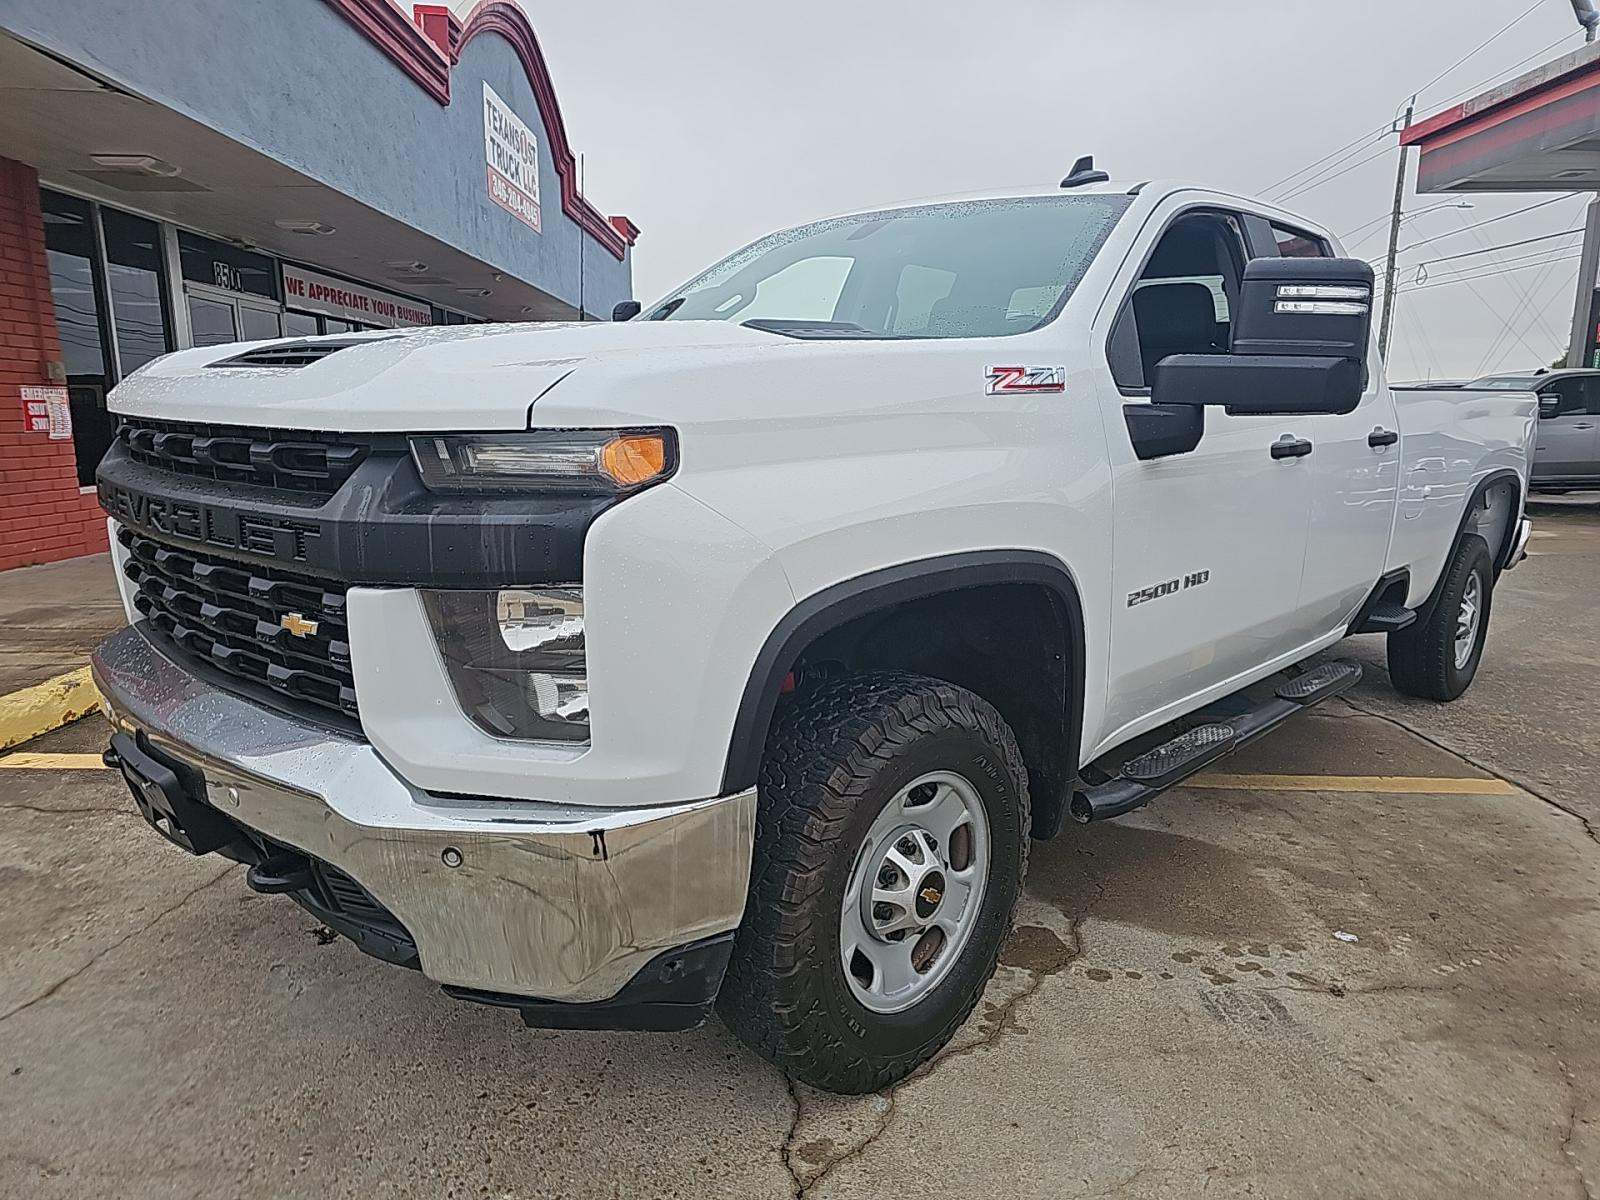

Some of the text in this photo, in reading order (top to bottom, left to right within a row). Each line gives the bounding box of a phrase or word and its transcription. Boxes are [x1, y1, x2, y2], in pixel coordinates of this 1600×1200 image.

[486, 97, 520, 154] TEXANS
[490, 135, 521, 187] TRUCK
[285, 276, 432, 326] WE APPRECIATE YOUR BUSINESS
[985, 365, 1066, 396] Z71
[1127, 569, 1210, 608] 2500 HD
